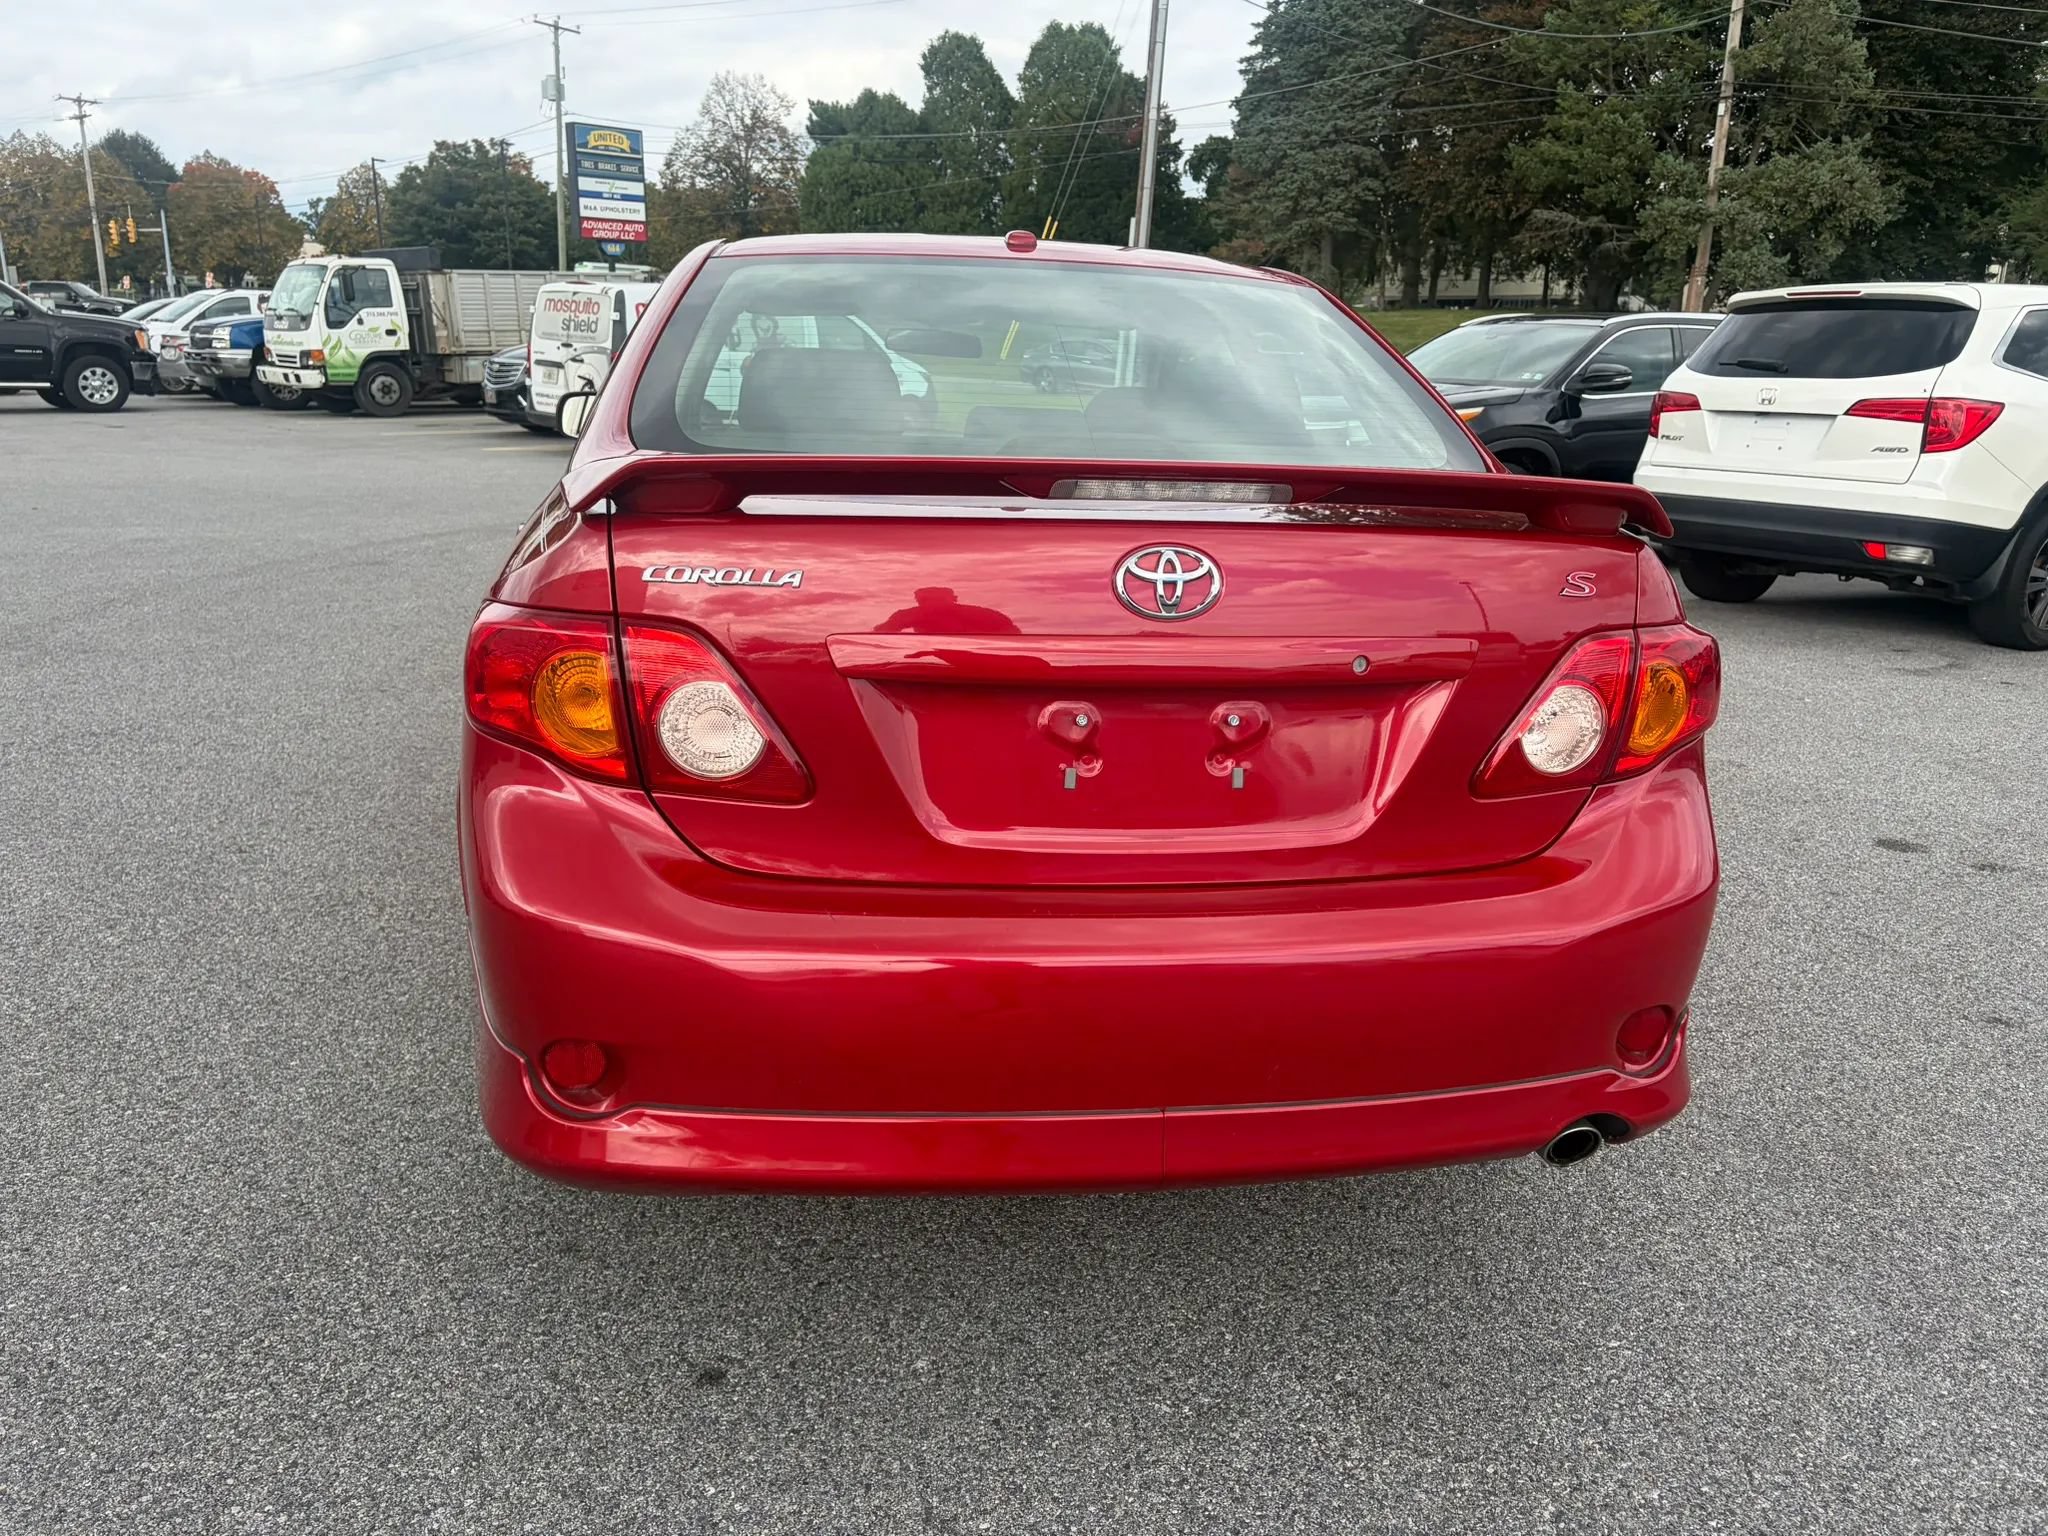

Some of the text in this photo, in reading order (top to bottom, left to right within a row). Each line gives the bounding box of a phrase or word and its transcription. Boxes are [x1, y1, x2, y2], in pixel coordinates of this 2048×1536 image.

[593, 132, 624, 146] UNITED
[620, 165, 640, 173] SERVICE
[600, 206, 641, 215] UPHOLSTERY
[582, 220, 645, 232] ADVANCED AUTO
[592, 230, 636, 240] GROUP LLC
[544, 297, 600, 319] mosquito
[561, 314, 599, 333] shield
[1660, 434, 1685, 442] PILOT
[641, 565, 804, 588] COROLLA
[1559, 571, 1597, 598] S
